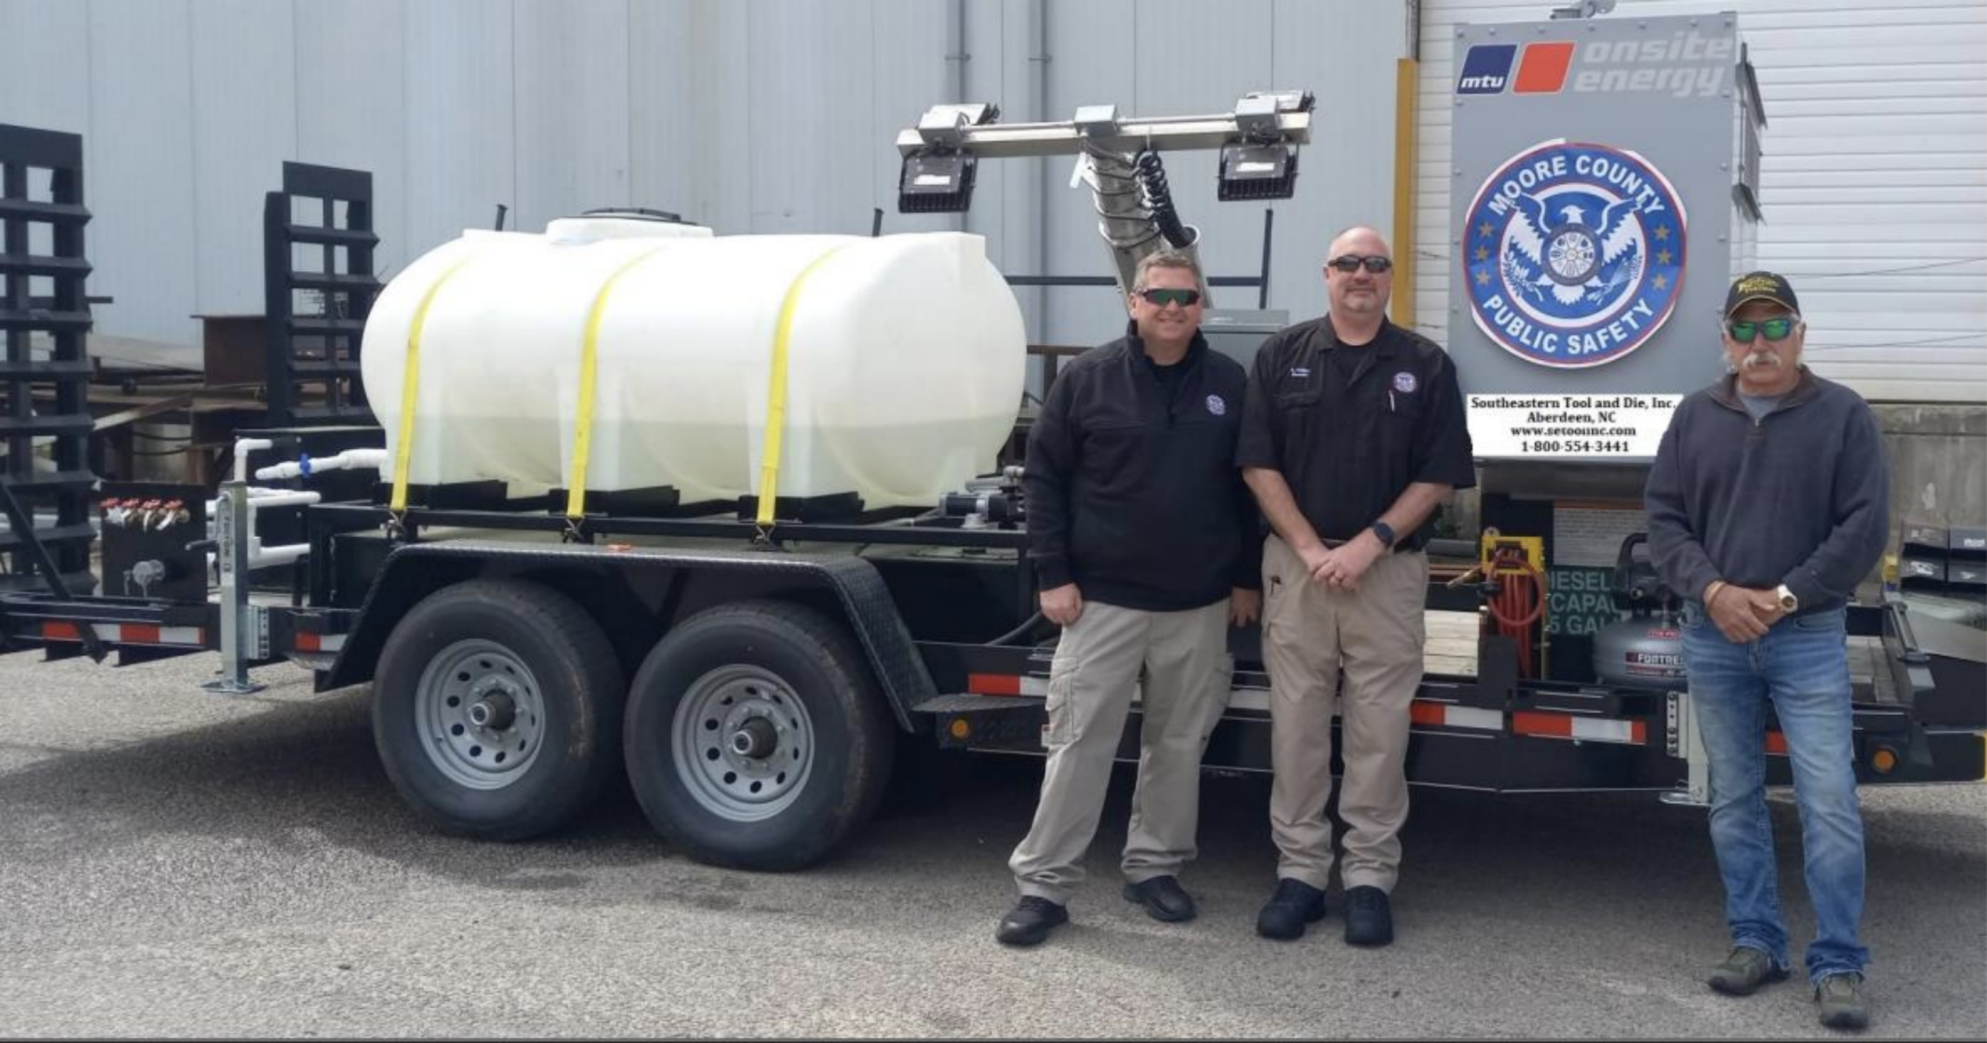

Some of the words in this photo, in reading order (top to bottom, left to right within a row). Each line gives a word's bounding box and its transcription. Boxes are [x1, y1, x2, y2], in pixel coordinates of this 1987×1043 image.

[1583, 31, 1736, 64] onsite
[1461, 75, 1504, 90] mtu
[1573, 66, 1725, 98] energy
[1487, 155, 1568, 217] MOORE
[1575, 155, 1666, 215] COUNTY
[1482, 294, 1559, 354] PUBLIC
[1567, 298, 1655, 355] SAFETY
[1471, 397, 1560, 409] Southeastern
[1563, 397, 1592, 409] Tool
[1595, 397, 1620, 409] and
[1623, 397, 1649, 410] Die,
[1652, 397, 1677, 409] Inc.
[1527, 411, 1596, 424] Aberdeen,
[1598, 411, 1617, 423] NC
[1521, 440, 1630, 452] 1-800-554-3441
[1550, 571, 1611, 591] IESEL
